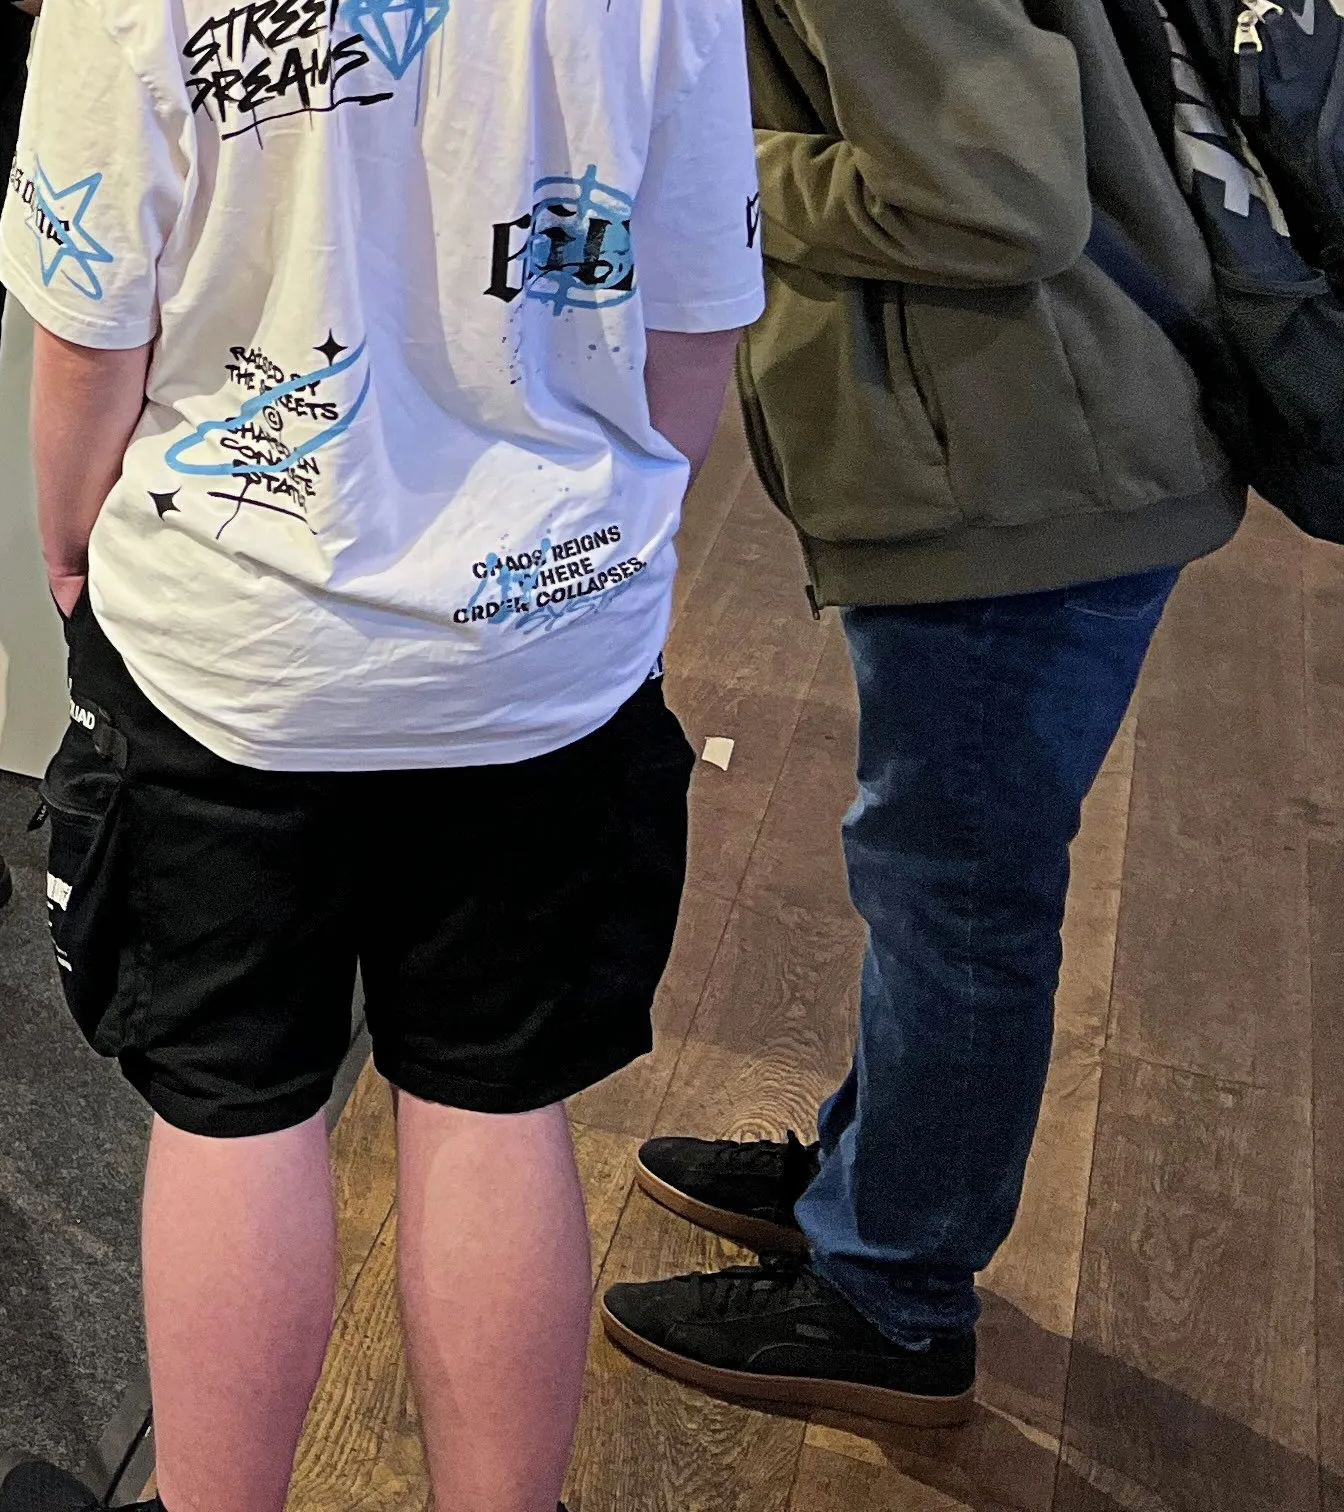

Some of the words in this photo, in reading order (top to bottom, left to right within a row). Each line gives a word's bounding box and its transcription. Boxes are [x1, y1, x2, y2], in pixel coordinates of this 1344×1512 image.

[225, 364, 255, 390] THE
[551, 525, 621, 562] REIGNS
[536, 556, 648, 608] COLLAPSES.
